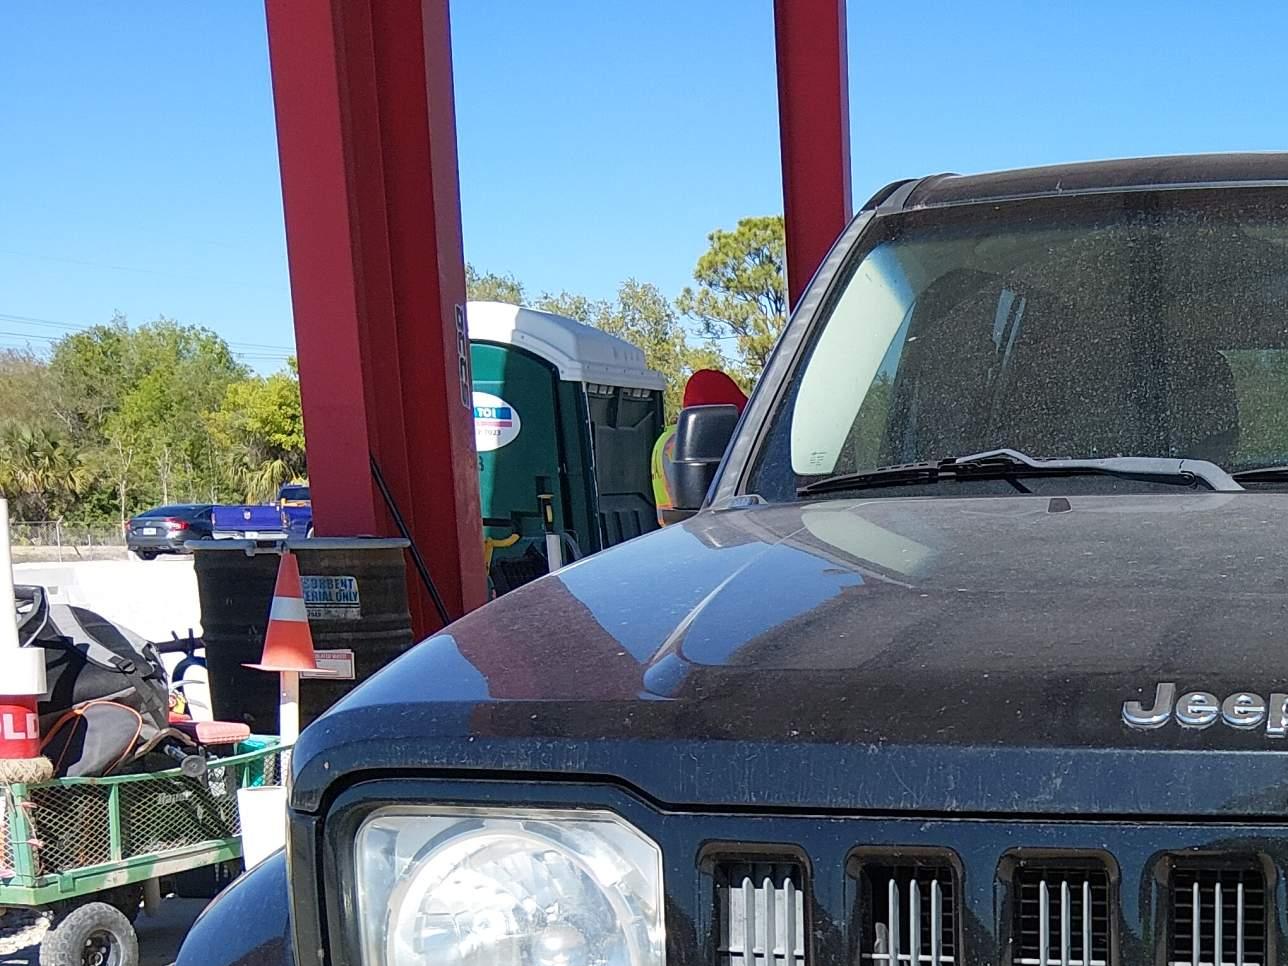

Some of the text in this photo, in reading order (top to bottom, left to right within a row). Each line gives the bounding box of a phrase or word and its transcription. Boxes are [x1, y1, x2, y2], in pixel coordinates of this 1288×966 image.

[302, 578, 354, 590] SORBENT
[305, 591, 359, 602] ERIAL ONLY
